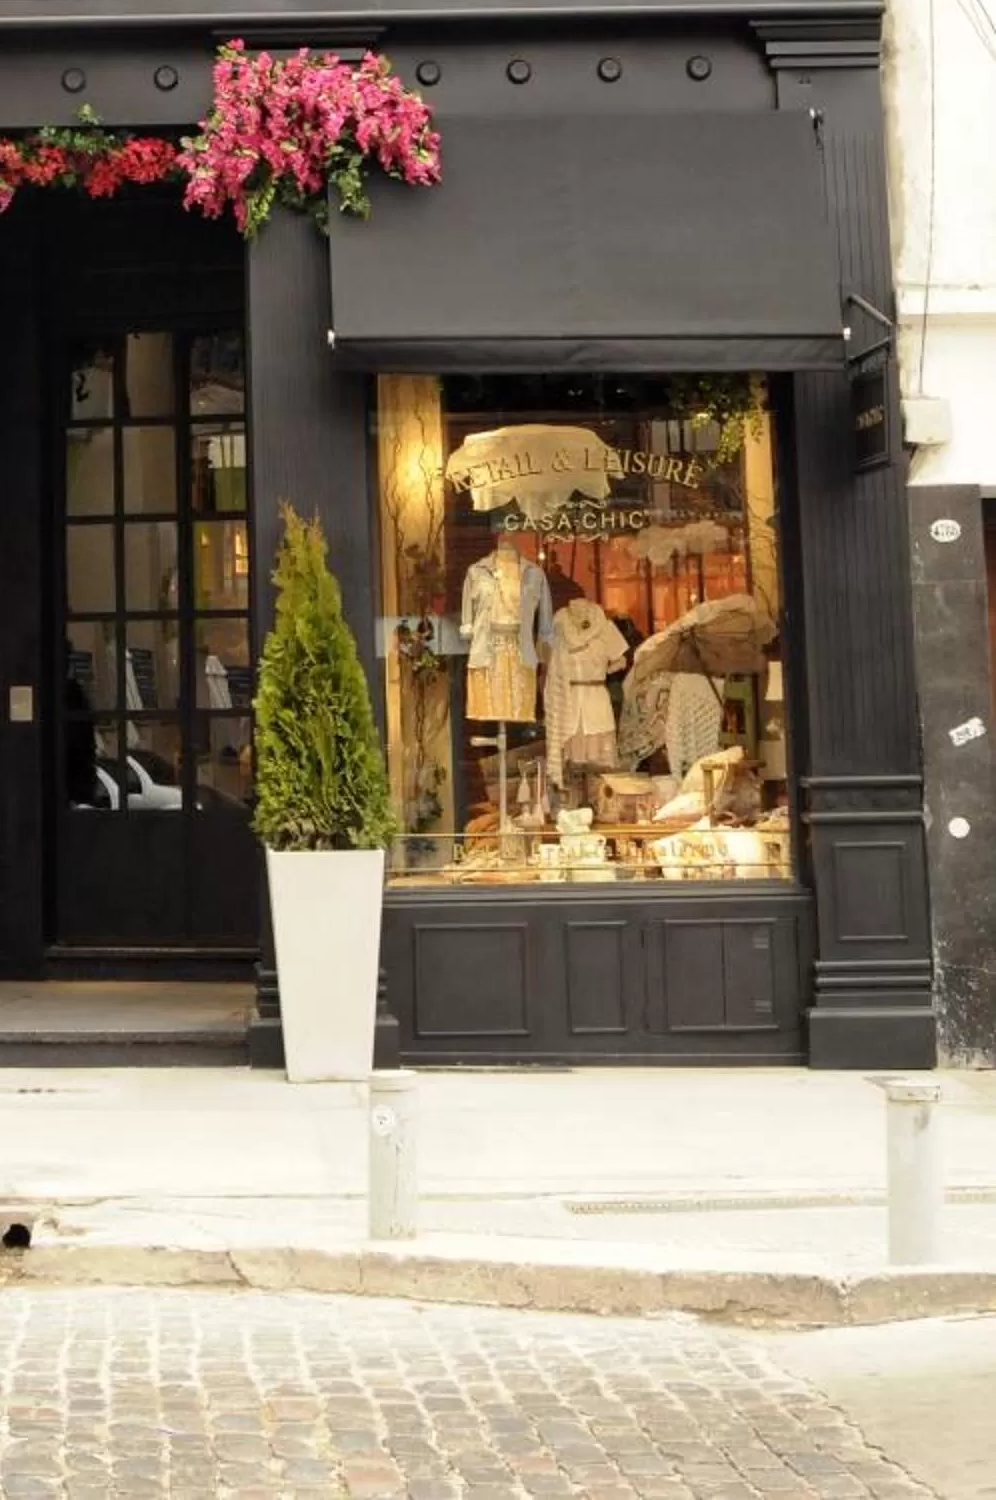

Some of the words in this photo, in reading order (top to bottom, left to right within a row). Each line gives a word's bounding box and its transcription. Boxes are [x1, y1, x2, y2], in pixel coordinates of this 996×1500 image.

[451, 451, 543, 494] RETAIL
[551, 447, 573, 474] &
[583, 447, 705, 490] LEISURE
[504, 509, 646, 532] CASA-CHIC
